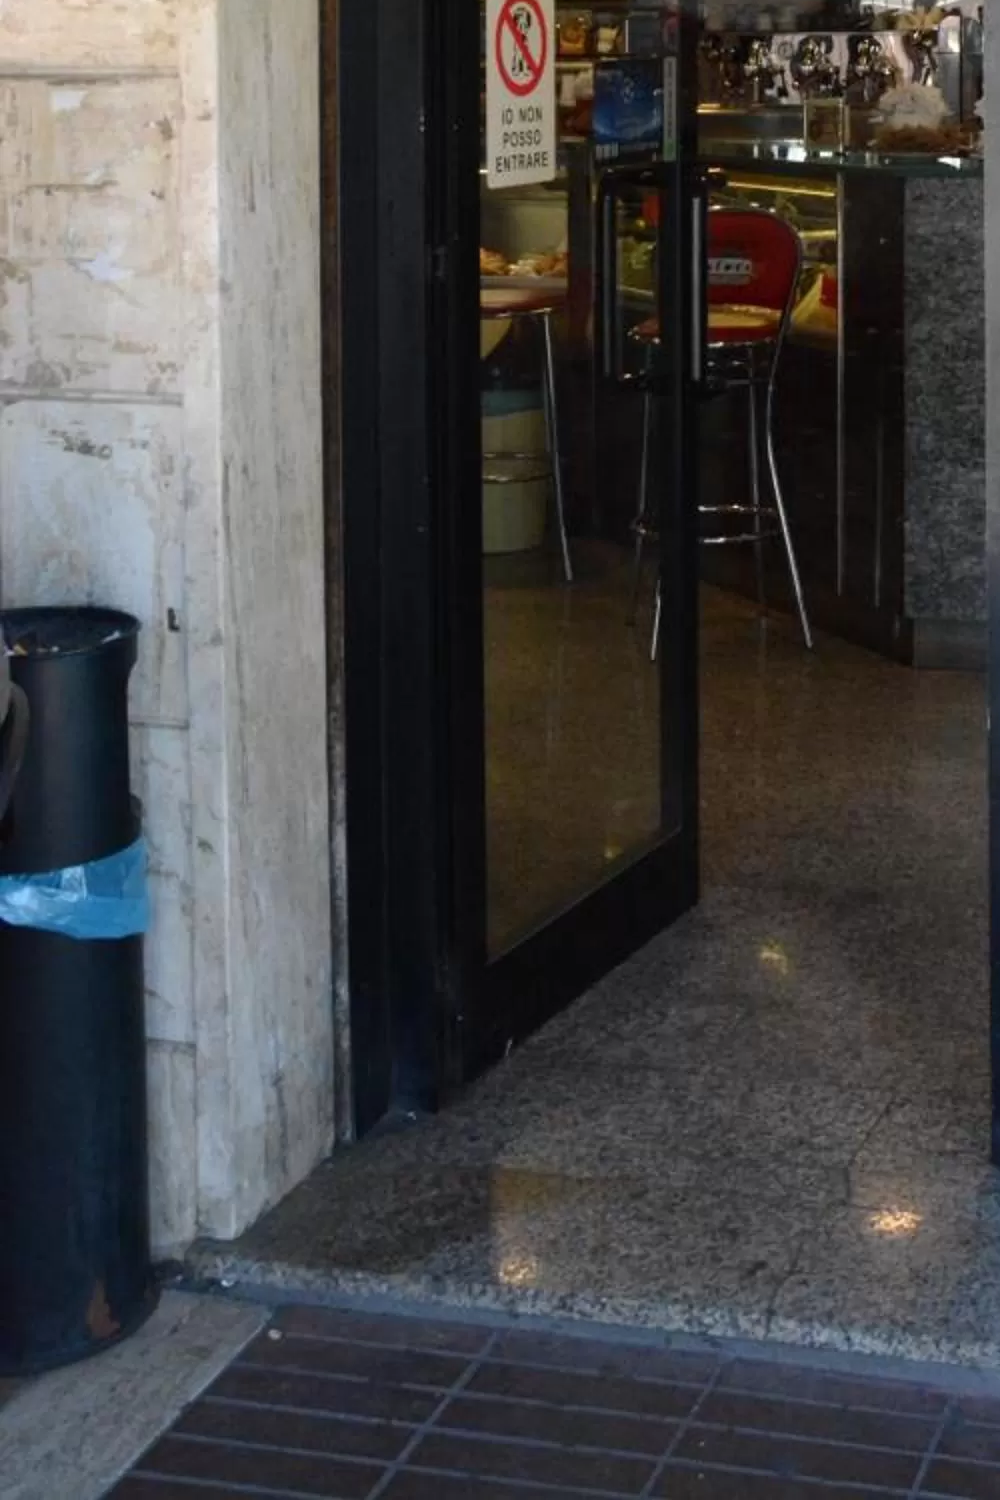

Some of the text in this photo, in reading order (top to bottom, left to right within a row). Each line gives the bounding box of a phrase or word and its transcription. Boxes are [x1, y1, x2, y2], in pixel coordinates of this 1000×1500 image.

[501, 105, 543, 125] IO NON
[502, 128, 542, 149] POSSO
[495, 150, 549, 174] ENTRARE
